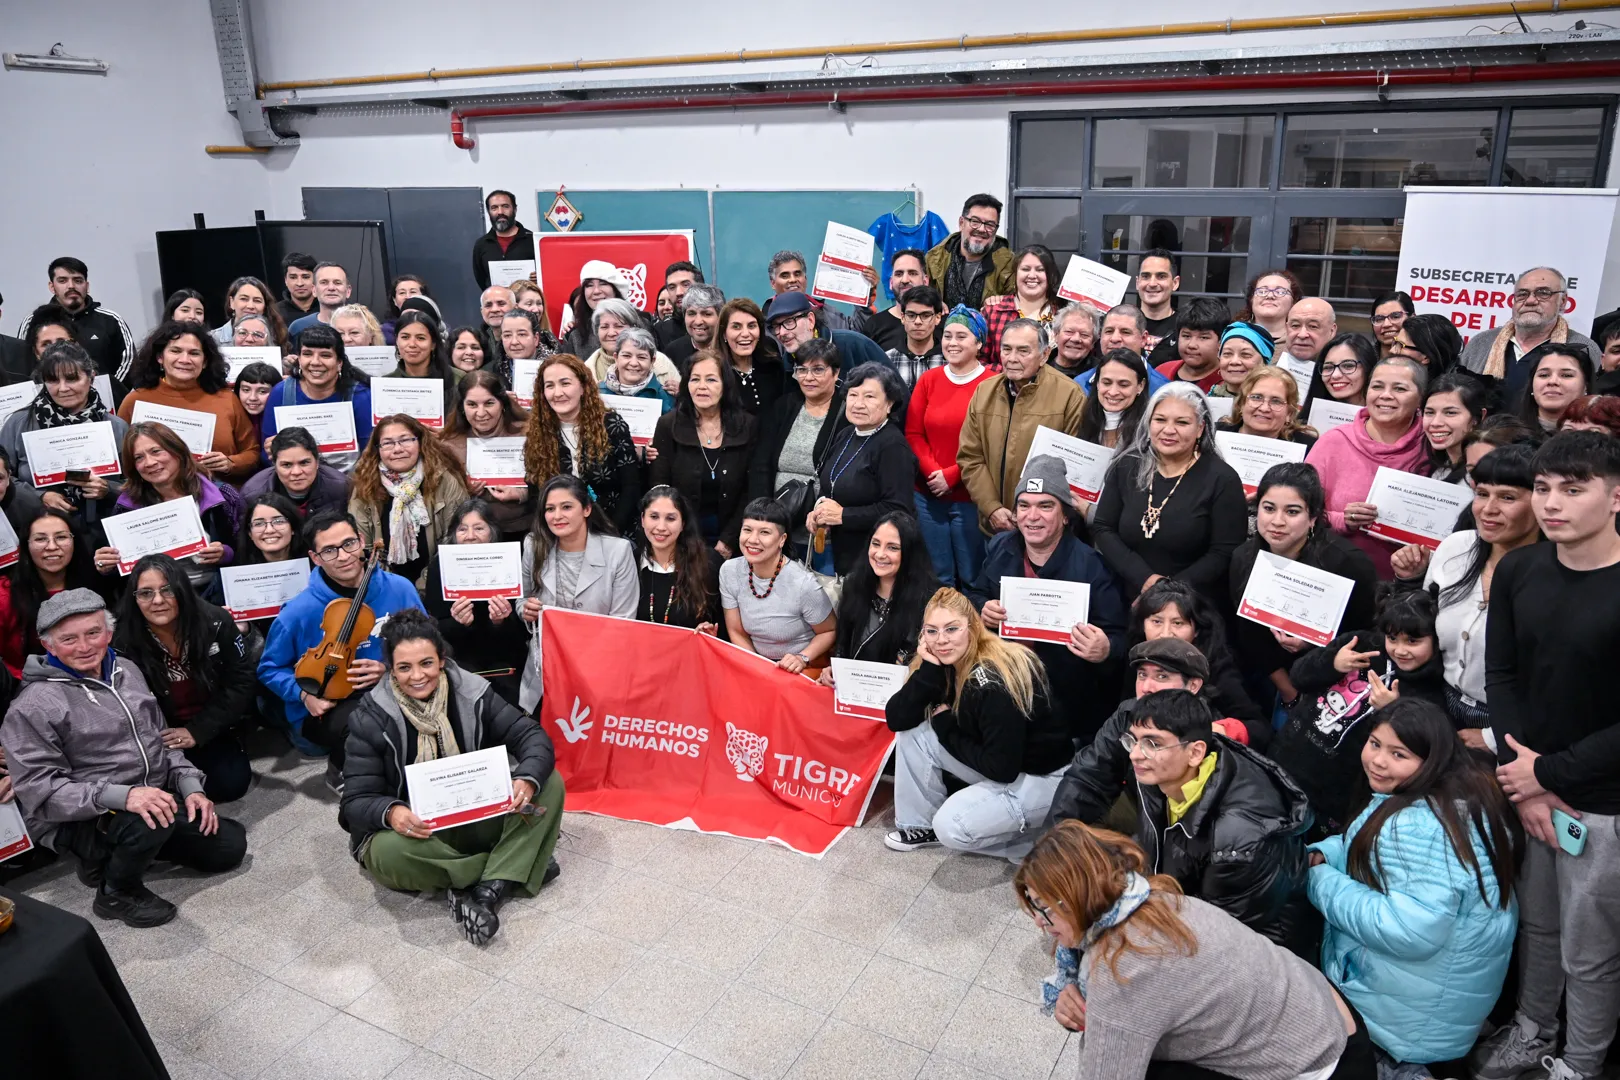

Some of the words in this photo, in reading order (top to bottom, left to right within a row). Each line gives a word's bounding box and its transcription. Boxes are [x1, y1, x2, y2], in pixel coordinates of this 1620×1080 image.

[1410, 267, 1516, 285] SUBSECRETA
[1451, 311, 1482, 330] DE
[1064, 447, 1083, 458] MERCEDES
[1403, 488, 1436, 501] ALEJANDRINA
[1436, 498, 1460, 507] LATORRE
[1274, 572, 1292, 581] JOHANA
[1293, 578, 1314, 589] SOLEDAD
[604, 714, 709, 742] DERECHOS
[601, 730, 700, 758] HUMANOS
[446, 770, 467, 779] ELISABET
